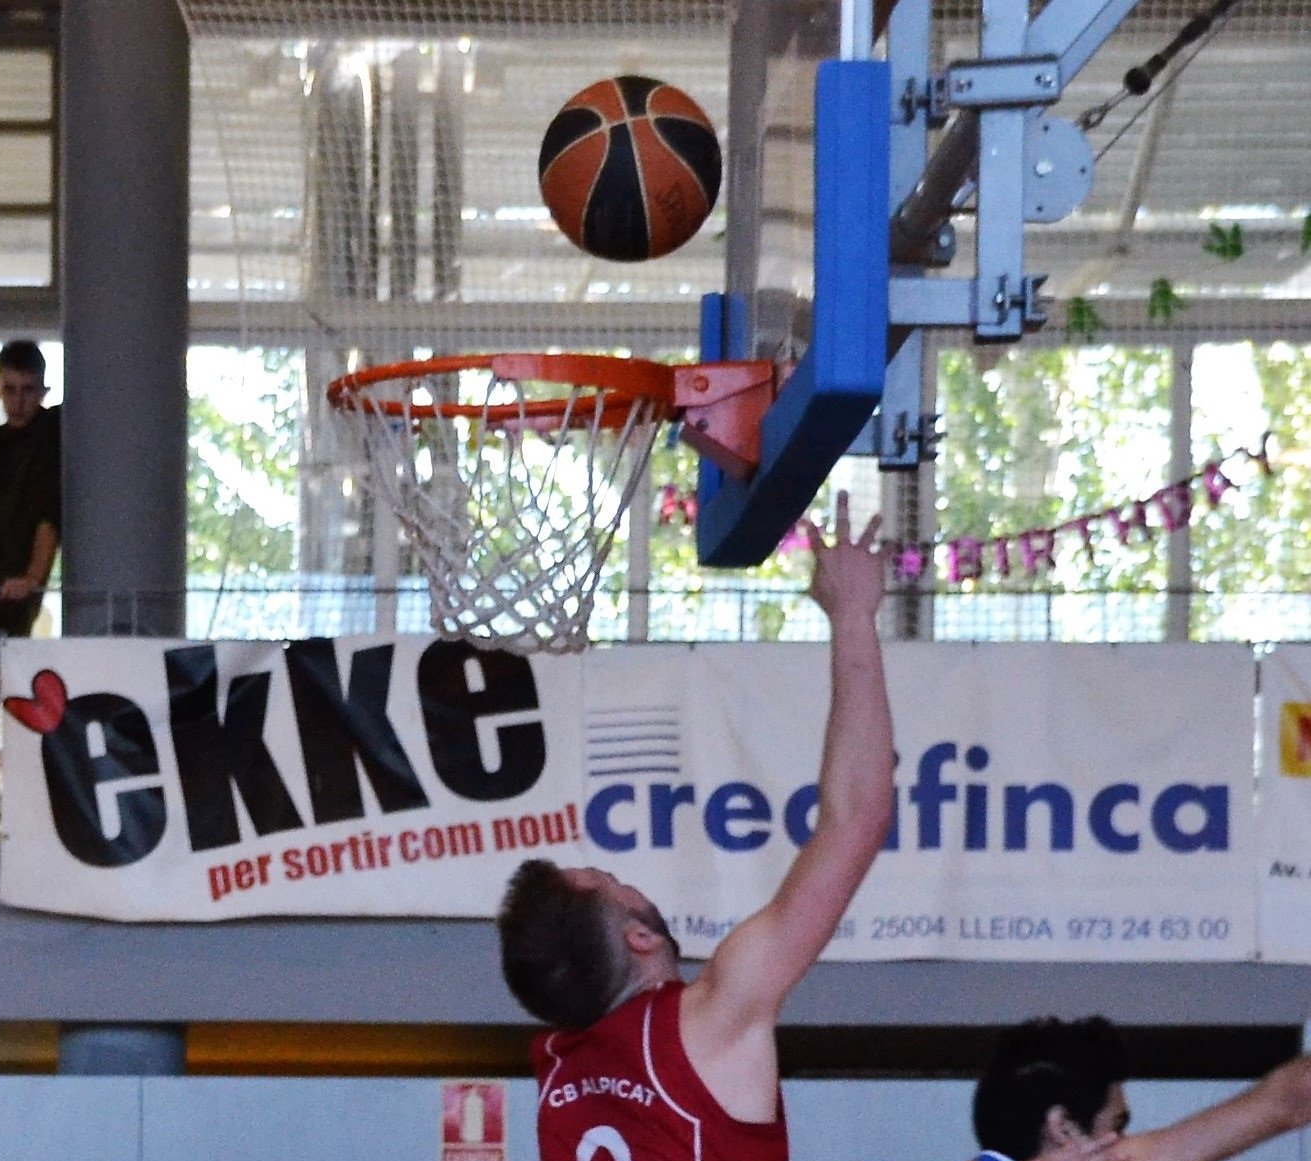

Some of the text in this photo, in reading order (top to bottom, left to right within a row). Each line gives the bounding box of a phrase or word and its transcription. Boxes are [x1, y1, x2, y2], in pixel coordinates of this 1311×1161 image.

[42, 636, 548, 869] ekke
[207, 803, 582, 902] per sortir com nou!
[870, 915, 946, 941] 25004
[959, 916, 1054, 941] LLEIDA
[1066, 917, 1113, 941] 973
[1121, 916, 1152, 940] 24
[1159, 917, 1191, 941] 63
[1198, 917, 1230, 941] 00
[549, 1076, 656, 1108] CB ALPICAT
